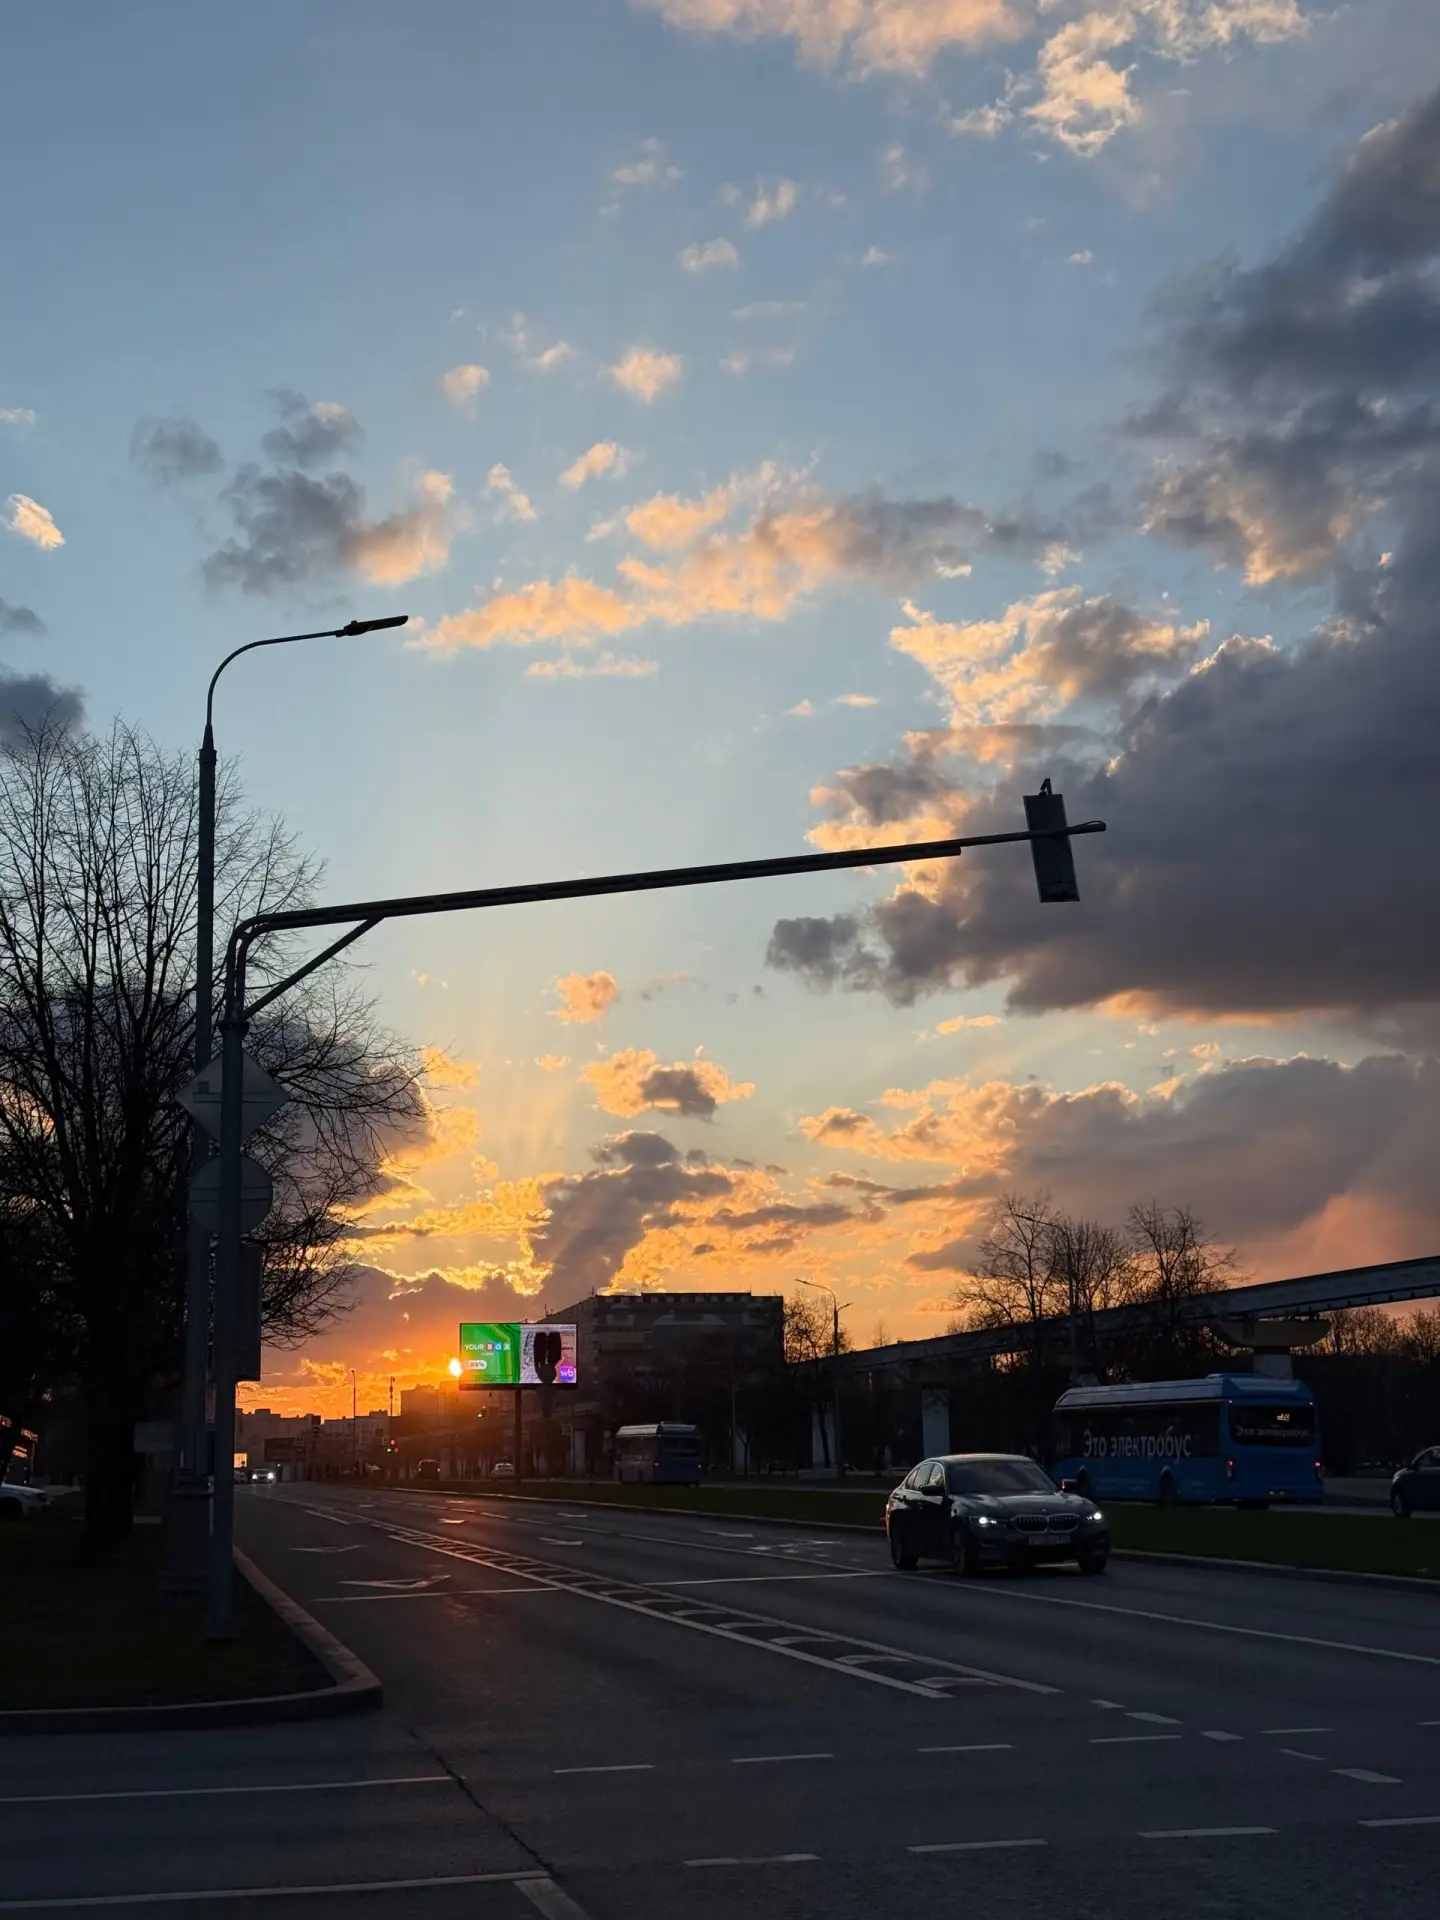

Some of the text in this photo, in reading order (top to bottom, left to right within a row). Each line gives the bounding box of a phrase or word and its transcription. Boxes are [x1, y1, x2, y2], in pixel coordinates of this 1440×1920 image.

[464, 1343, 484, 1351] YOUR
[1083, 1424, 1192, 1465] Это электробус
